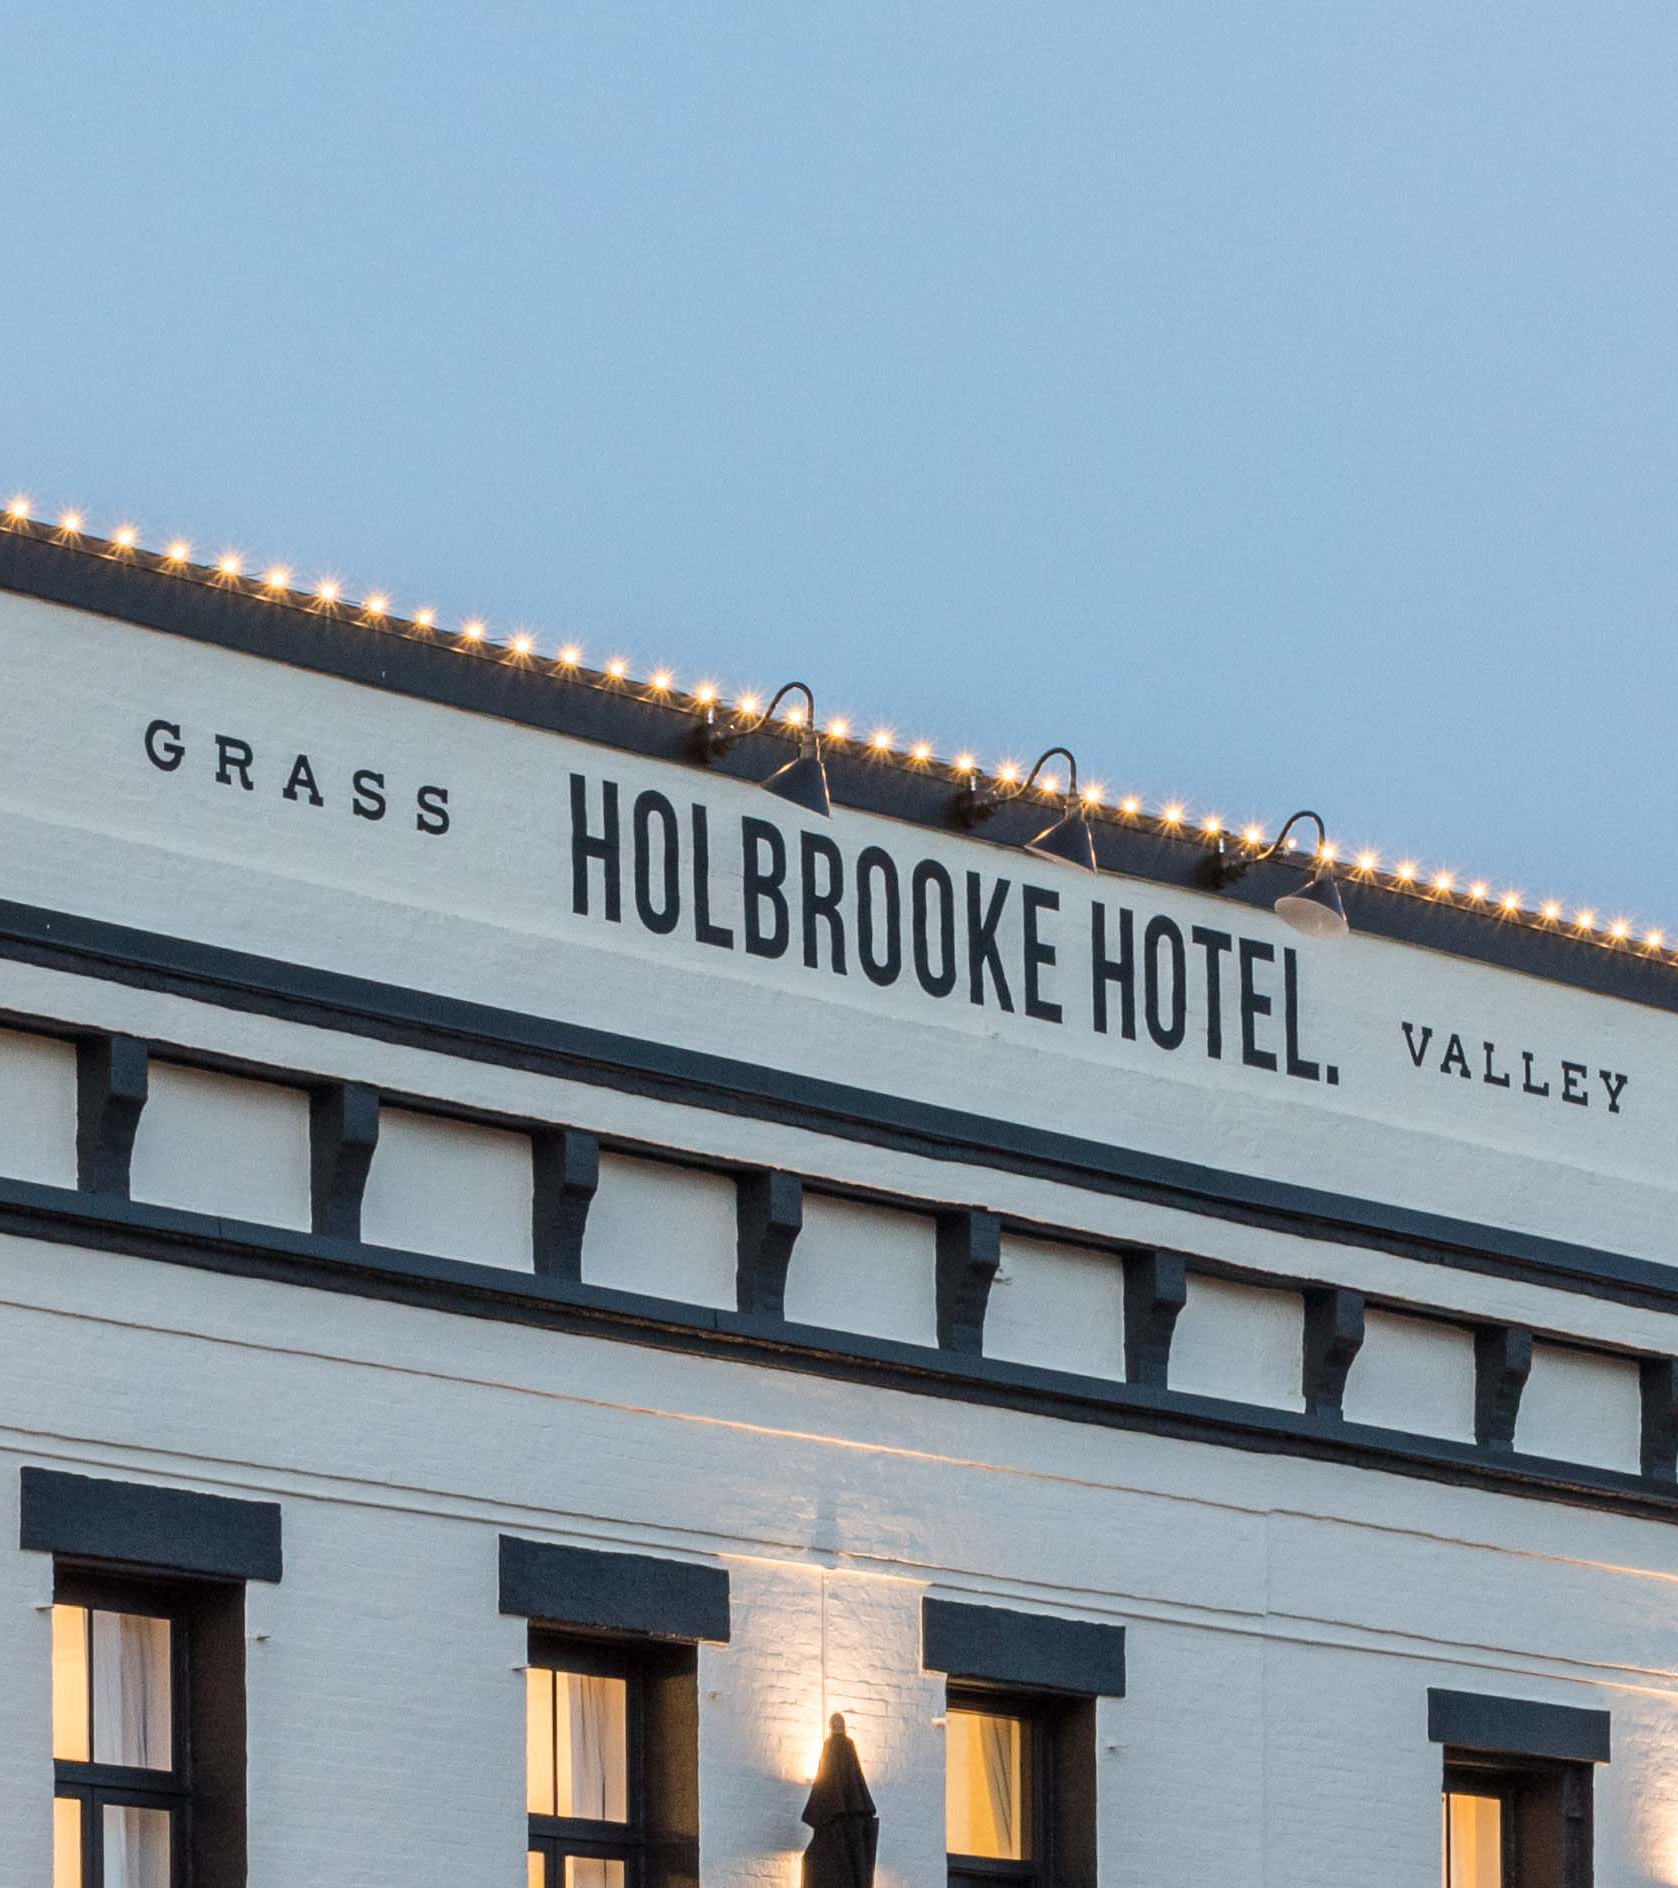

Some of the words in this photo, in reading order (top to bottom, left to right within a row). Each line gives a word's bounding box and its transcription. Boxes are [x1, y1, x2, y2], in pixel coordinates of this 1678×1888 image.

[144, 719, 450, 836] GRASS
[569, 773, 1063, 1025] HOLBROOKE
[1091, 900, 1339, 1086] HOTEL.
[1401, 1021, 1628, 1114] VALLEY
